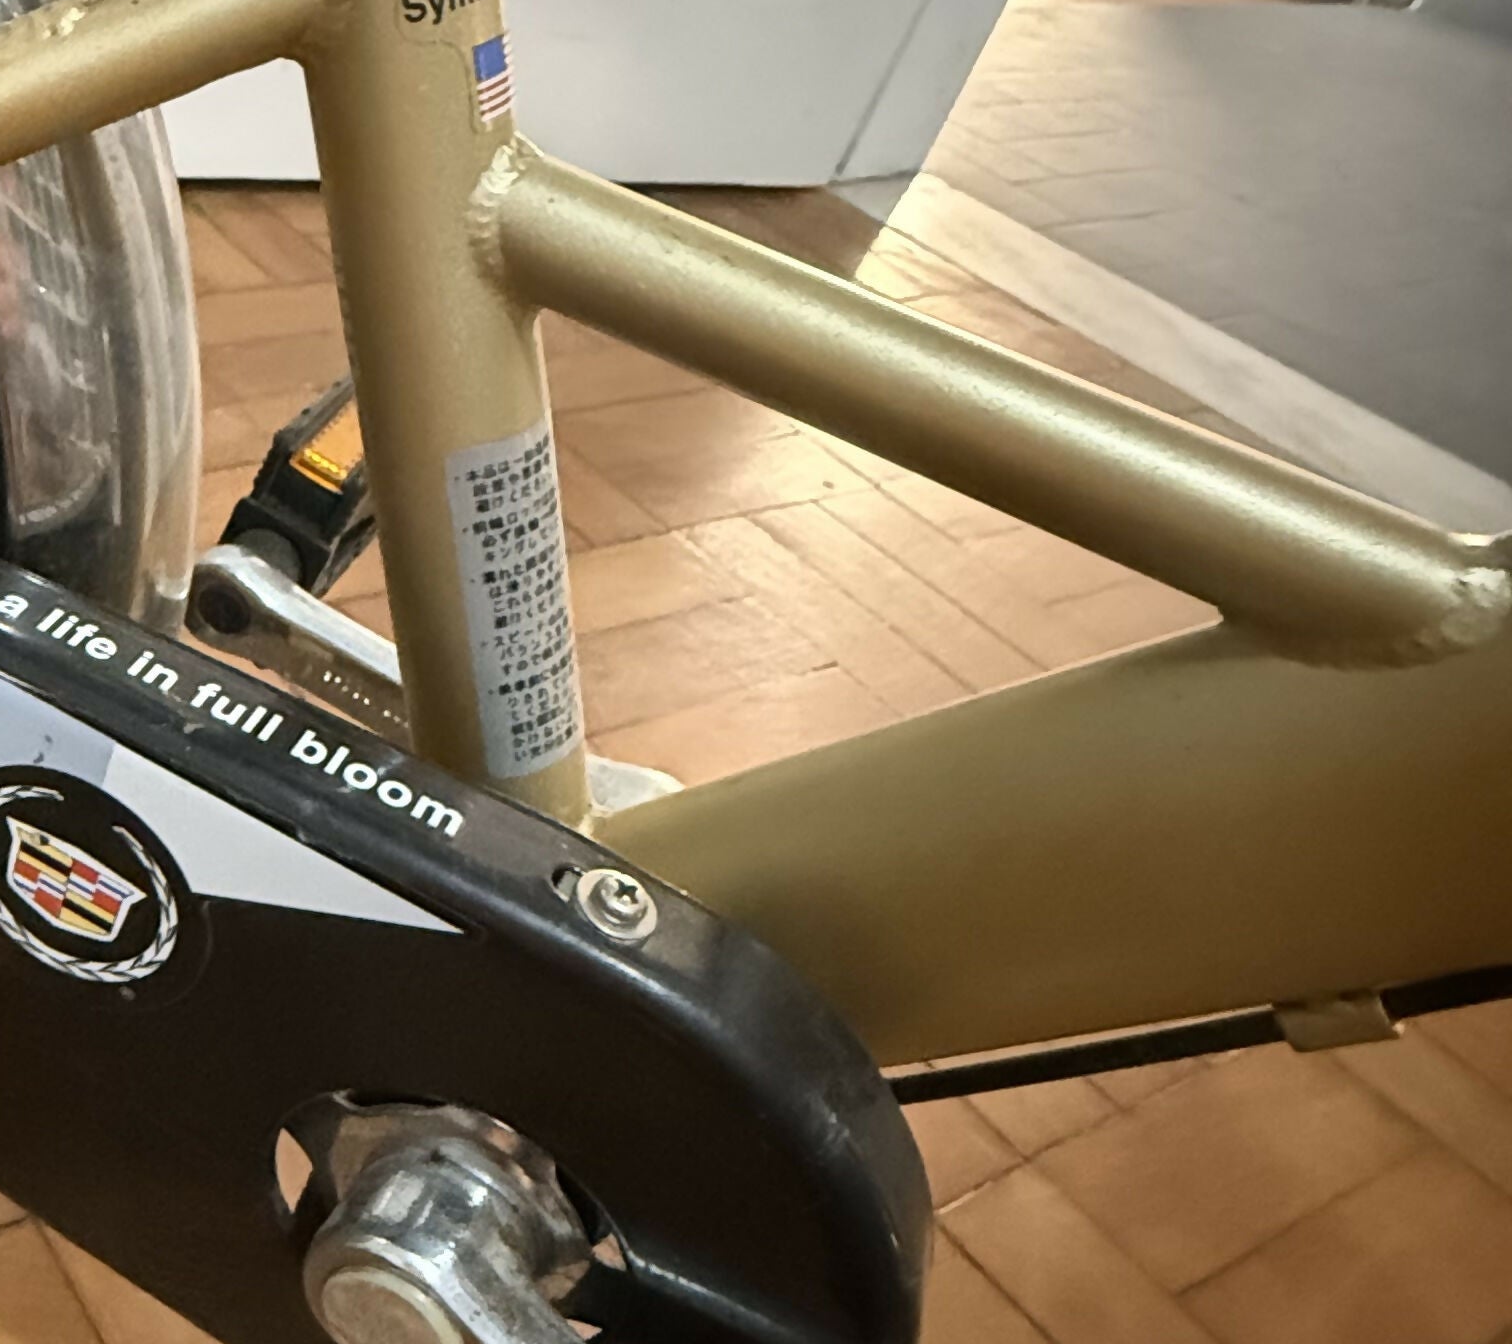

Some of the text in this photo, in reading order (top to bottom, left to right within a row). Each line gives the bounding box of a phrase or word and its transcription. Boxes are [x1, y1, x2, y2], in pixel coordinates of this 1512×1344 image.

[36, 607, 118, 661] life
[126, 649, 180, 694] in
[189, 682, 285, 743] full
[289, 728, 465, 838] bloom
